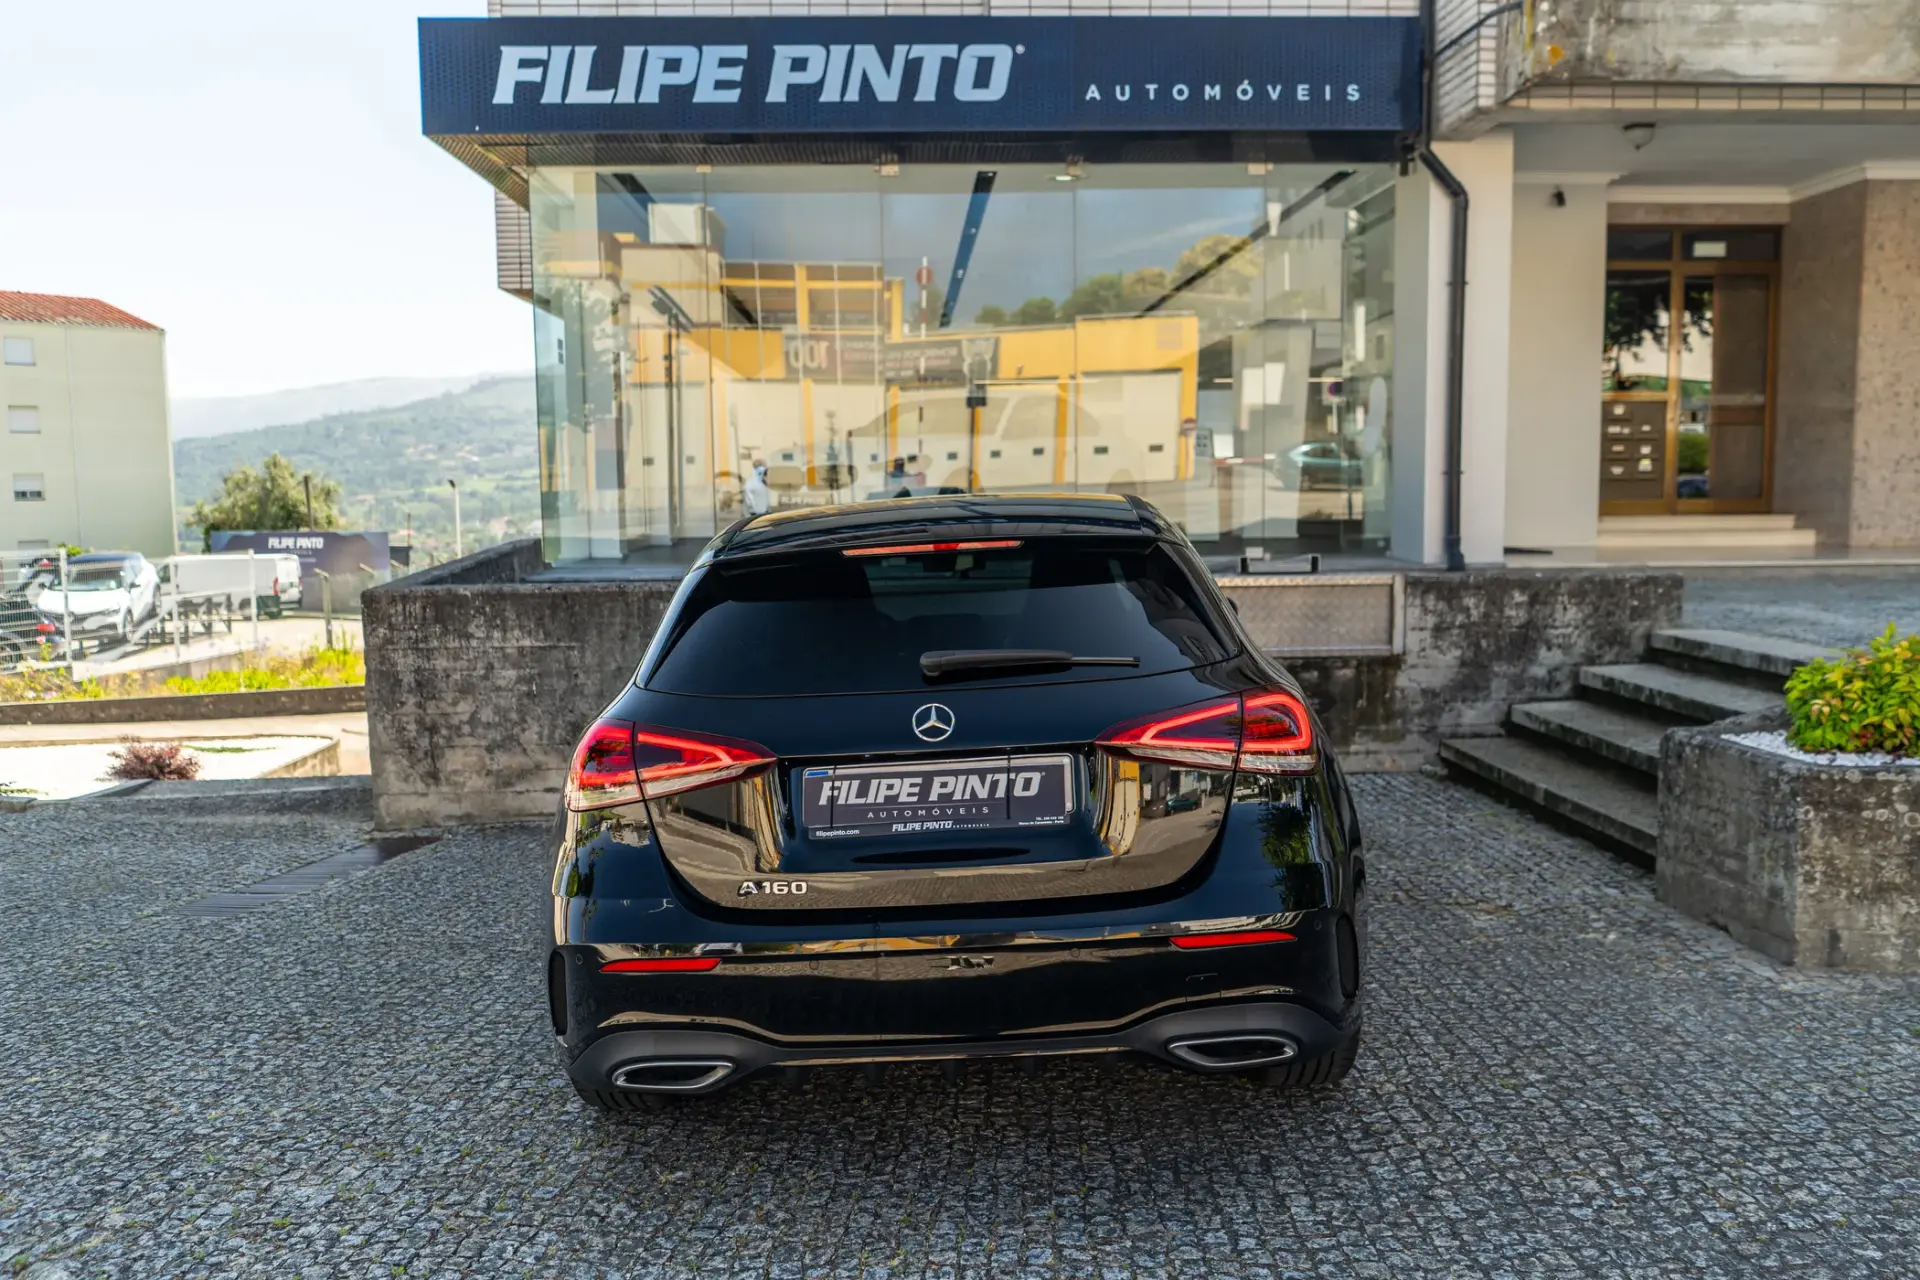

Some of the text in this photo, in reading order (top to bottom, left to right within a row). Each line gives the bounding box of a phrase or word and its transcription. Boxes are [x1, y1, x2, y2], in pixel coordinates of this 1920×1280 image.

[492, 43, 1361, 104] FILIPE PINTO AUTOMÓVEIS
[818, 771, 1041, 806] FILIPE PINTO
[867, 806, 989, 818] AUTOMÓVEIS
[892, 822, 922, 832] FILIPE
[923, 820, 953, 830] PINTO
